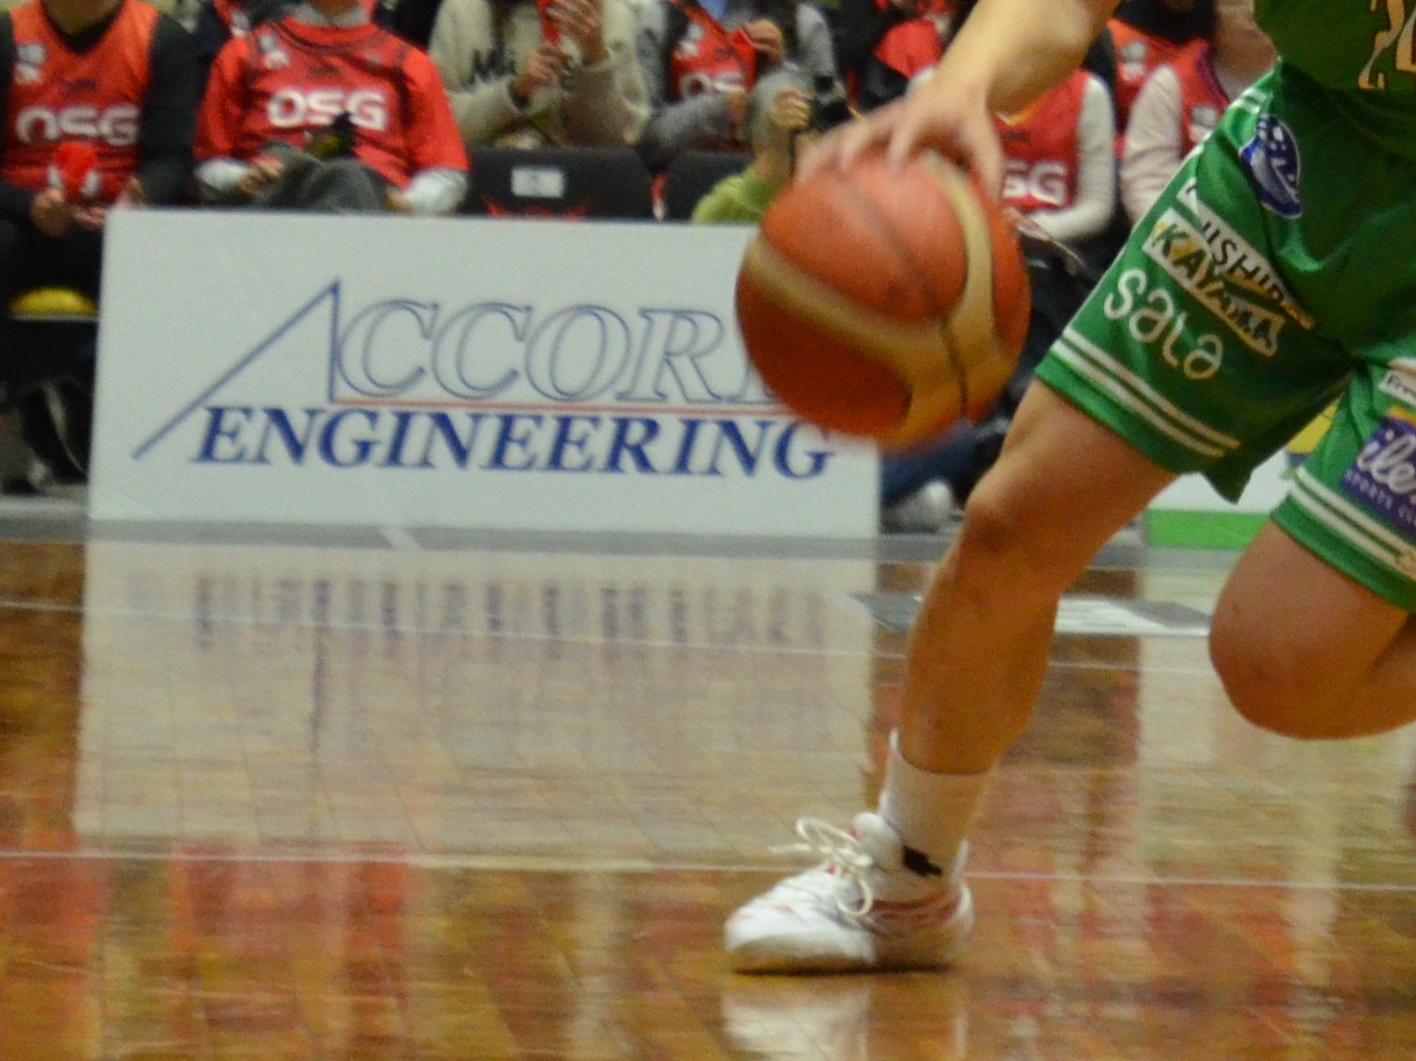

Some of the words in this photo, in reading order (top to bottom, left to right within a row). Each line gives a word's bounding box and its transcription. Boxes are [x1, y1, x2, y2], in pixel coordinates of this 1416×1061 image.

[16, 103, 140, 147] OSG
[267, 88, 391, 131] OSG
[1002, 160, 1067, 207] SG
[1103, 268, 1223, 380] sala
[130, 276, 778, 459] ACCOR
[188, 404, 835, 481] ENGINEERING
